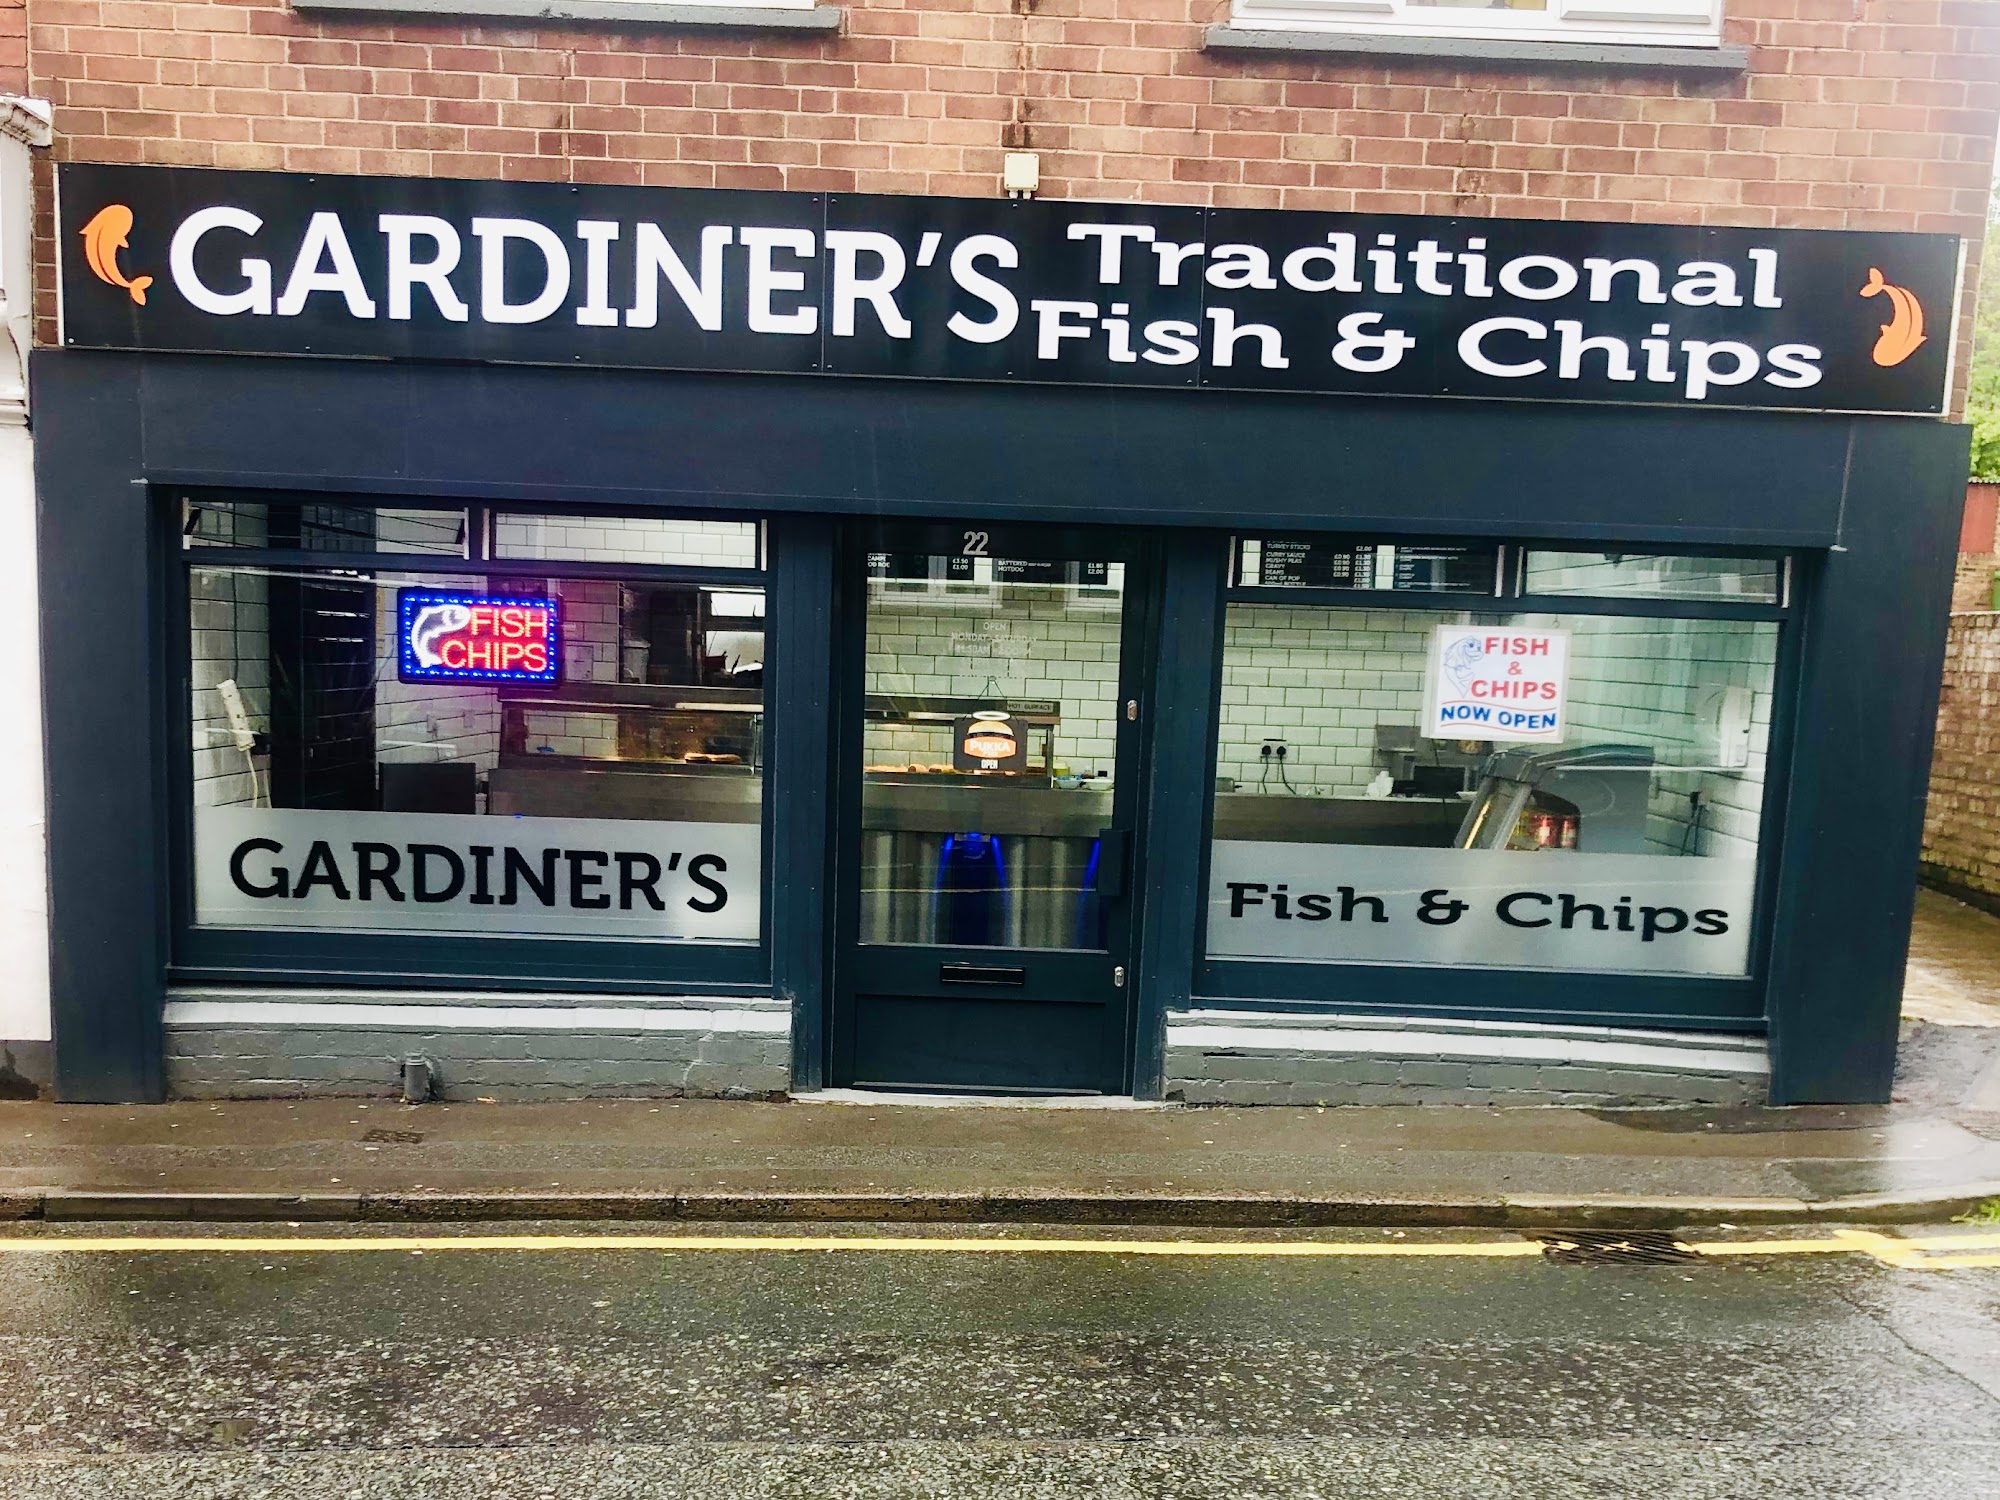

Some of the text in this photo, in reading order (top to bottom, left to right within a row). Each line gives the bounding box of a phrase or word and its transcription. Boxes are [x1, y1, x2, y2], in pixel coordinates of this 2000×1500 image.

[169, 206, 1019, 344] GARDINER'S
[1067, 223, 1783, 309] Traditional
[1030, 299, 1823, 400] Fish & Chips
[963, 531, 989, 556] 22
[470, 607, 548, 638] FISH
[983, 621, 1007, 631] OPEN
[441, 639, 547, 672] CHIPS
[1485, 636, 1549, 657] FISH
[1507, 660, 1522, 676] &
[1471, 679, 1557, 700] CHIPS
[1441, 704, 1557, 729] NOW OPEN
[969, 739, 1011, 752] PUKKA
[229, 837, 729, 914] GARDINER'S
[1226, 881, 1730, 942] Fish & Chips
